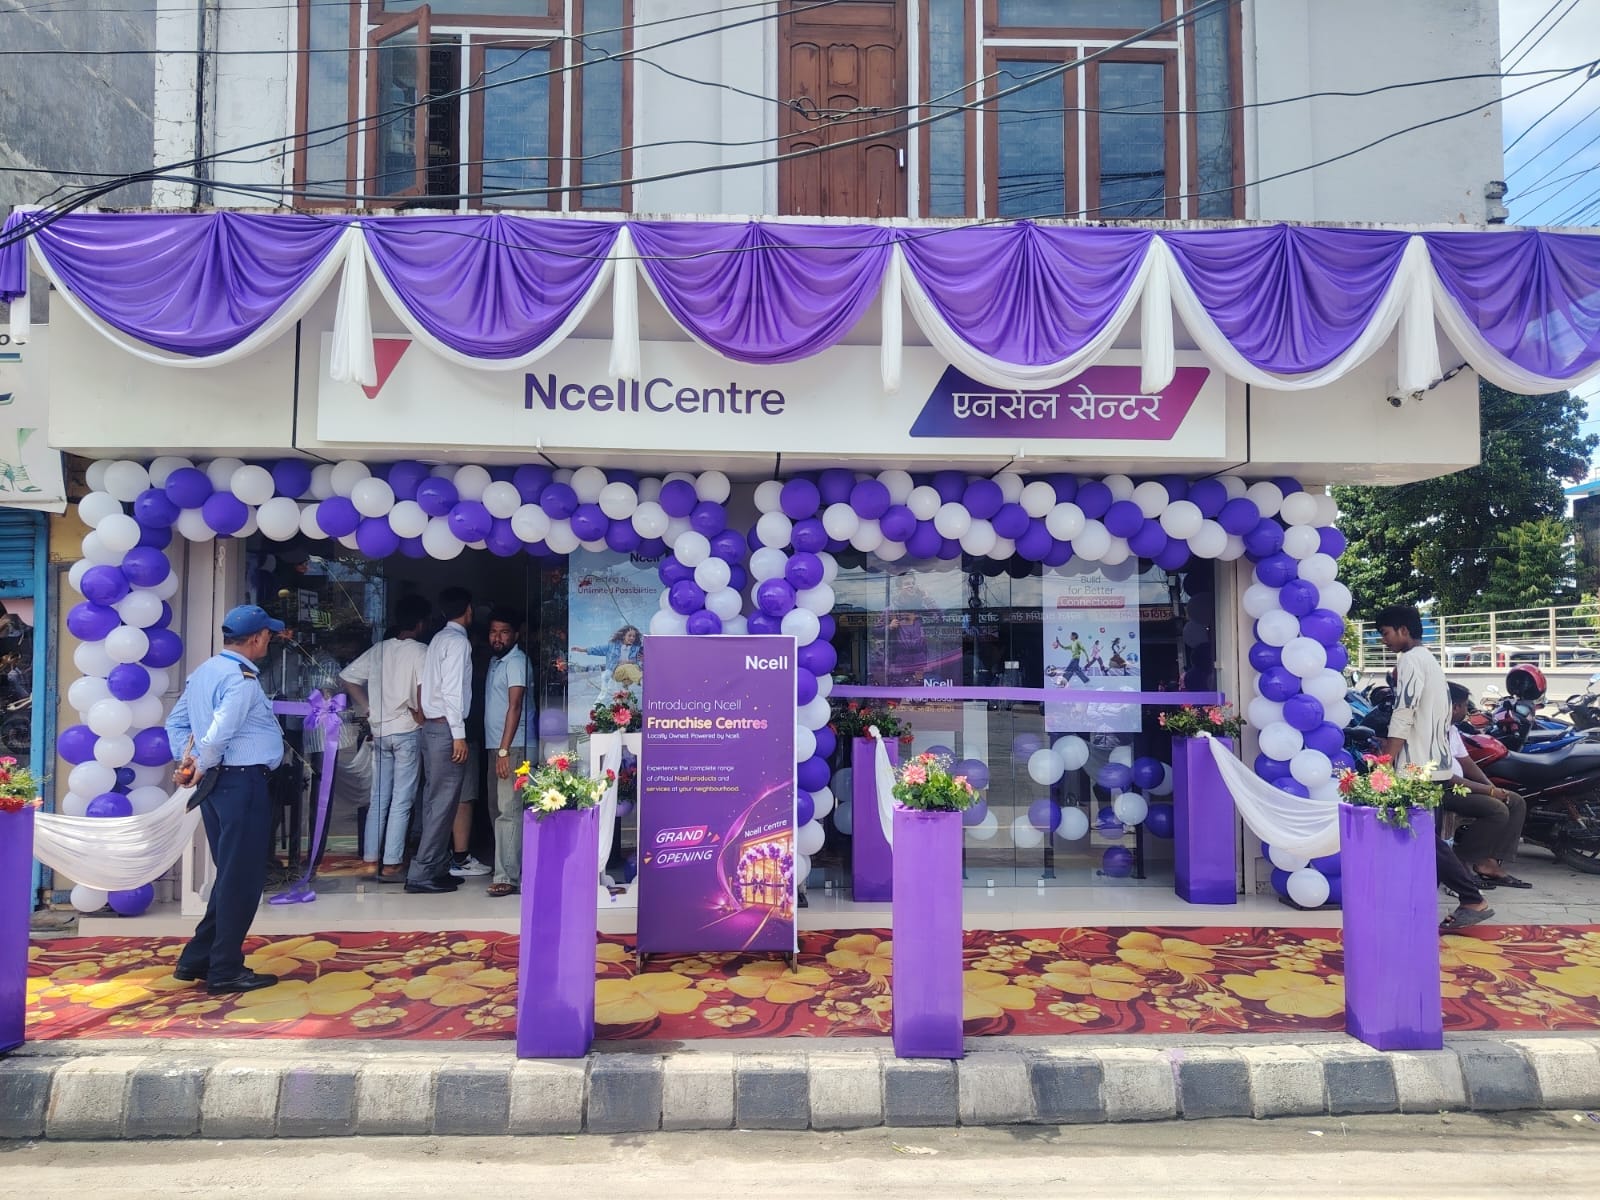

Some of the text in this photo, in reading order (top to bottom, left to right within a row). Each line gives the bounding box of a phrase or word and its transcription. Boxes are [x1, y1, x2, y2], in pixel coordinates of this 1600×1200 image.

[952, 384, 1163, 421] एनसेल सेन्टर
[1080, 575, 1101, 583] Build
[615, 586, 657, 594] Possibilities
[1068, 586, 1114, 594] for Better
[745, 655, 788, 670] Ncell
[923, 679, 953, 687] Ncell
[647, 700, 742, 712] Introducing Ncell
[647, 717, 768, 729] Franchise Centres
[690, 775, 717, 783] products
[744, 819, 788, 838] Ncell Centre
[655, 830, 704, 843] GRAND
[656, 849, 713, 864] OPENING
